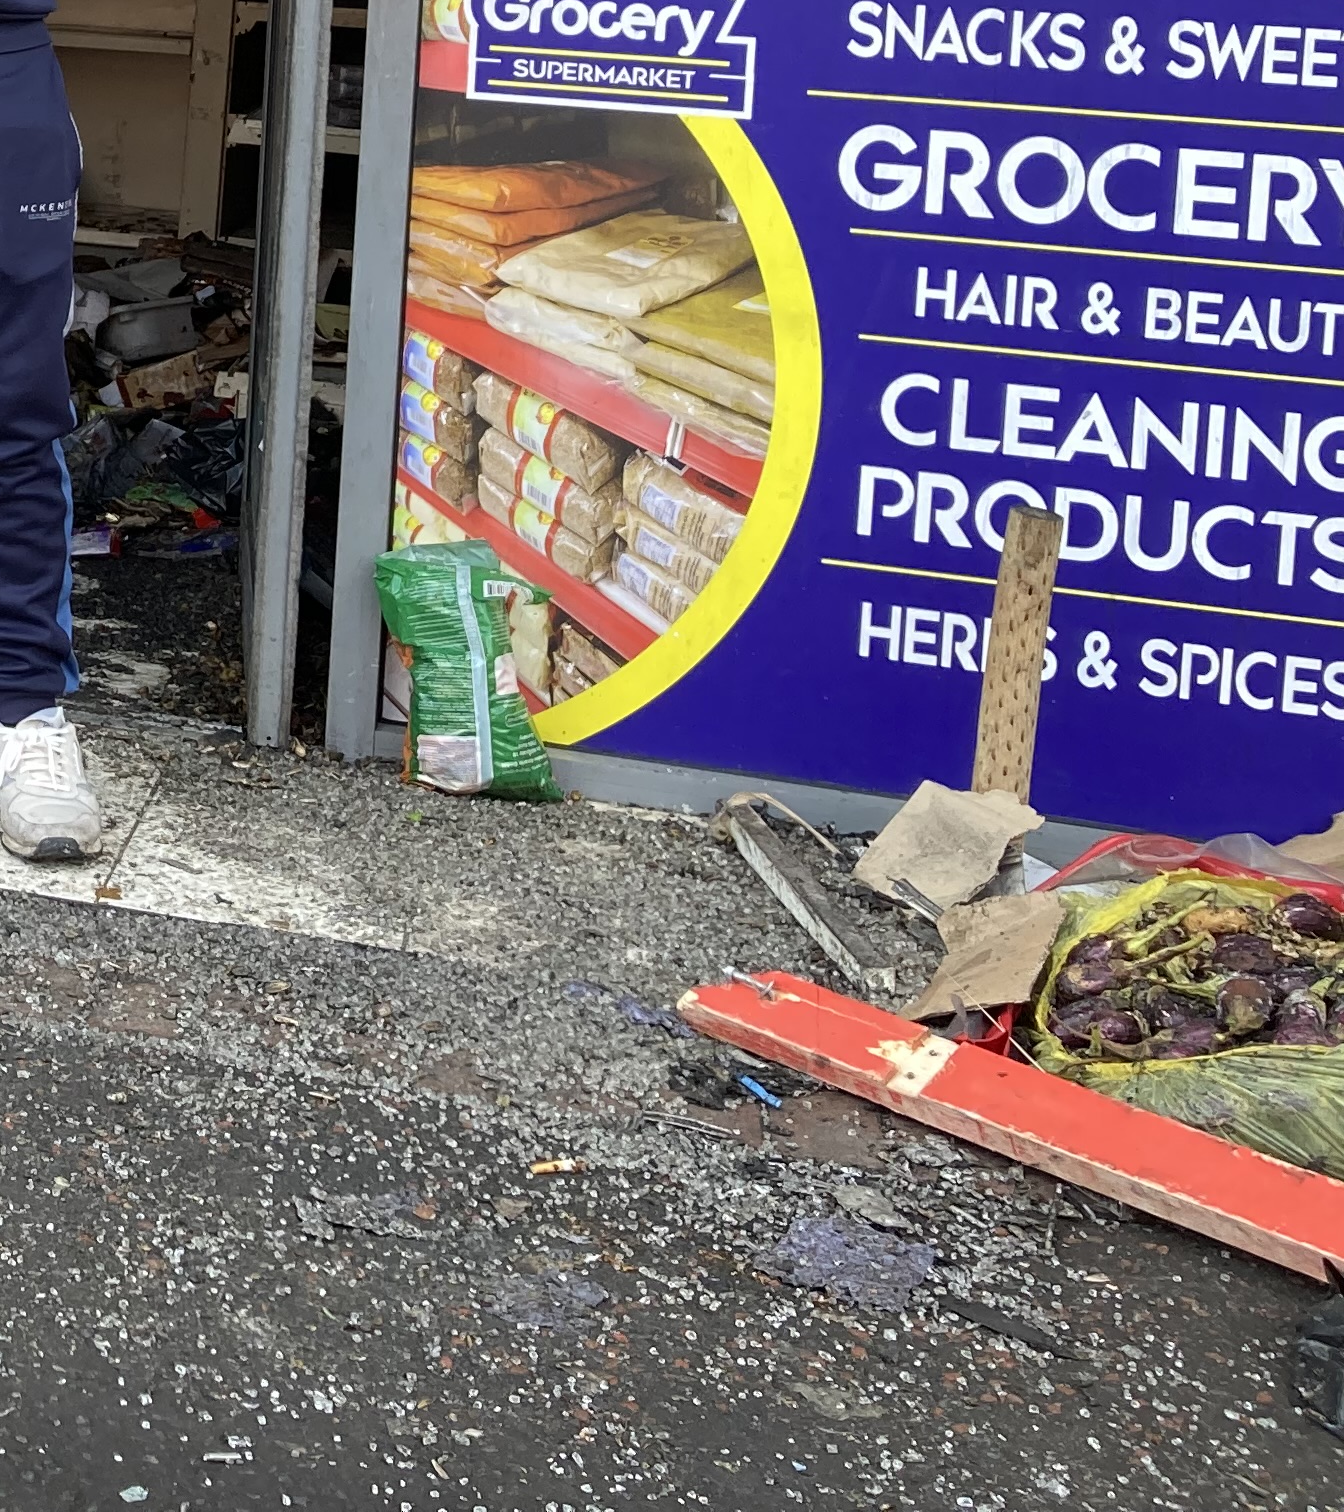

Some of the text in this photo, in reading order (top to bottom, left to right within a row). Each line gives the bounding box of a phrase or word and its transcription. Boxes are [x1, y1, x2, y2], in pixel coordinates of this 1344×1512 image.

[512, 58, 697, 90] SUPERMARKET
[846, 0, 1344, 88] SNACKS & SWEE
[914, 266, 1060, 331] HAIR
[1080, 281, 1121, 336] &
[858, 601, 1058, 683] HERS
[1076, 630, 1118, 691] &
